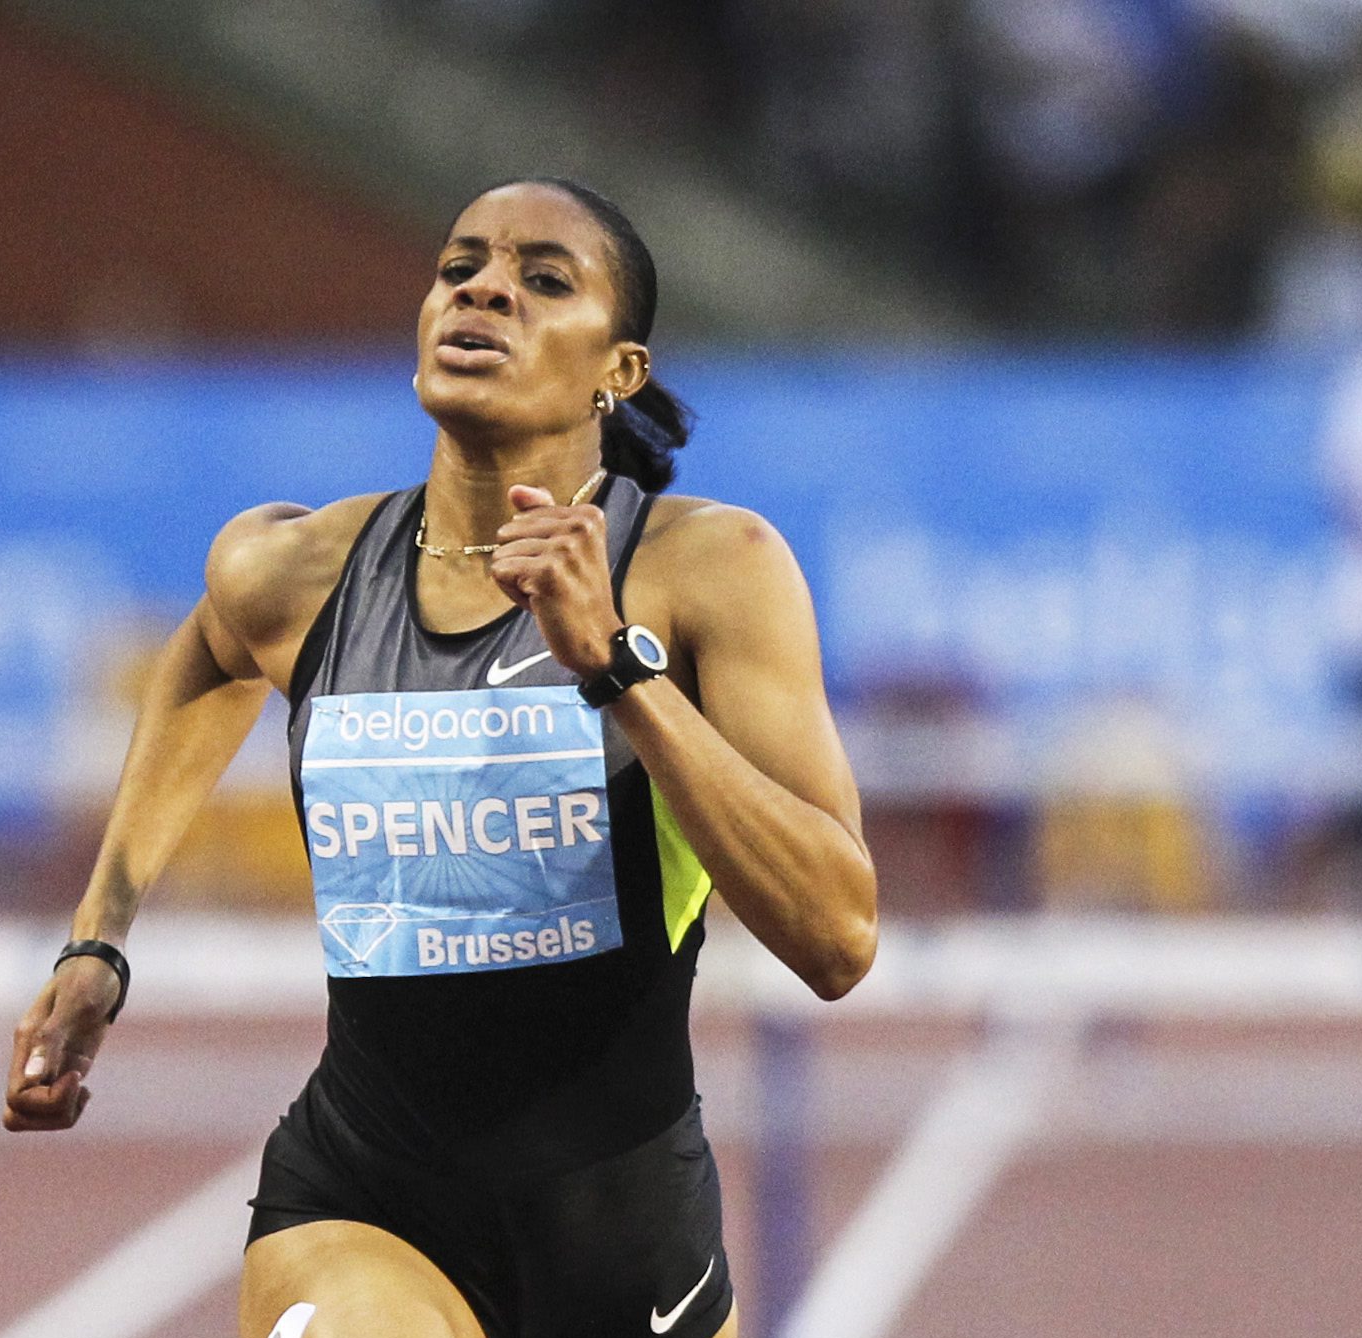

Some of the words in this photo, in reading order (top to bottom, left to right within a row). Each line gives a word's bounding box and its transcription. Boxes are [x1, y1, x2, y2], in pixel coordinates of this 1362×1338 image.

[340, 698, 554, 751] belgacom
[309, 793, 603, 858] SPENCER
[418, 917, 595, 967] Brussels
